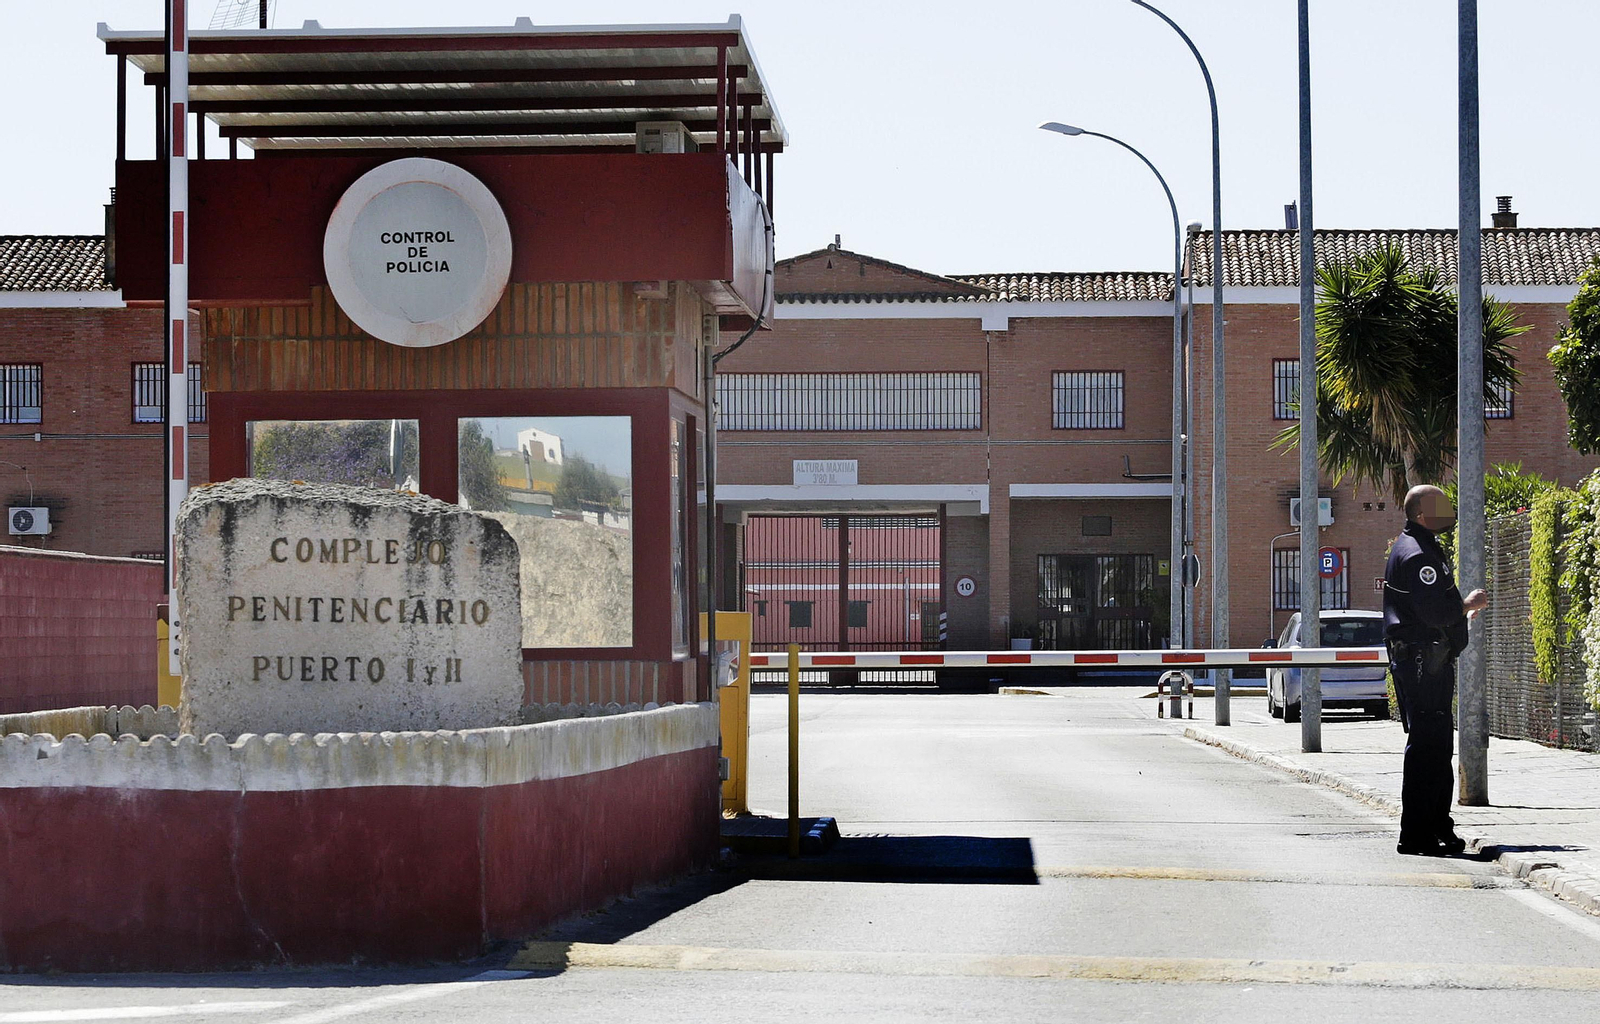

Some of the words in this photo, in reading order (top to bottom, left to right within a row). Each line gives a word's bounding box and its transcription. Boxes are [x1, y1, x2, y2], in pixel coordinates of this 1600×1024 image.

[381, 231, 454, 244] CONTROL
[408, 246, 428, 258] DE
[386, 260, 450, 273] POLICIA
[796, 462, 824, 473] ALTURA
[270, 536, 446, 566] COMPLEJO
[228, 596, 490, 625] PENITENCIARIO
[252, 656, 386, 683] PUERTO
